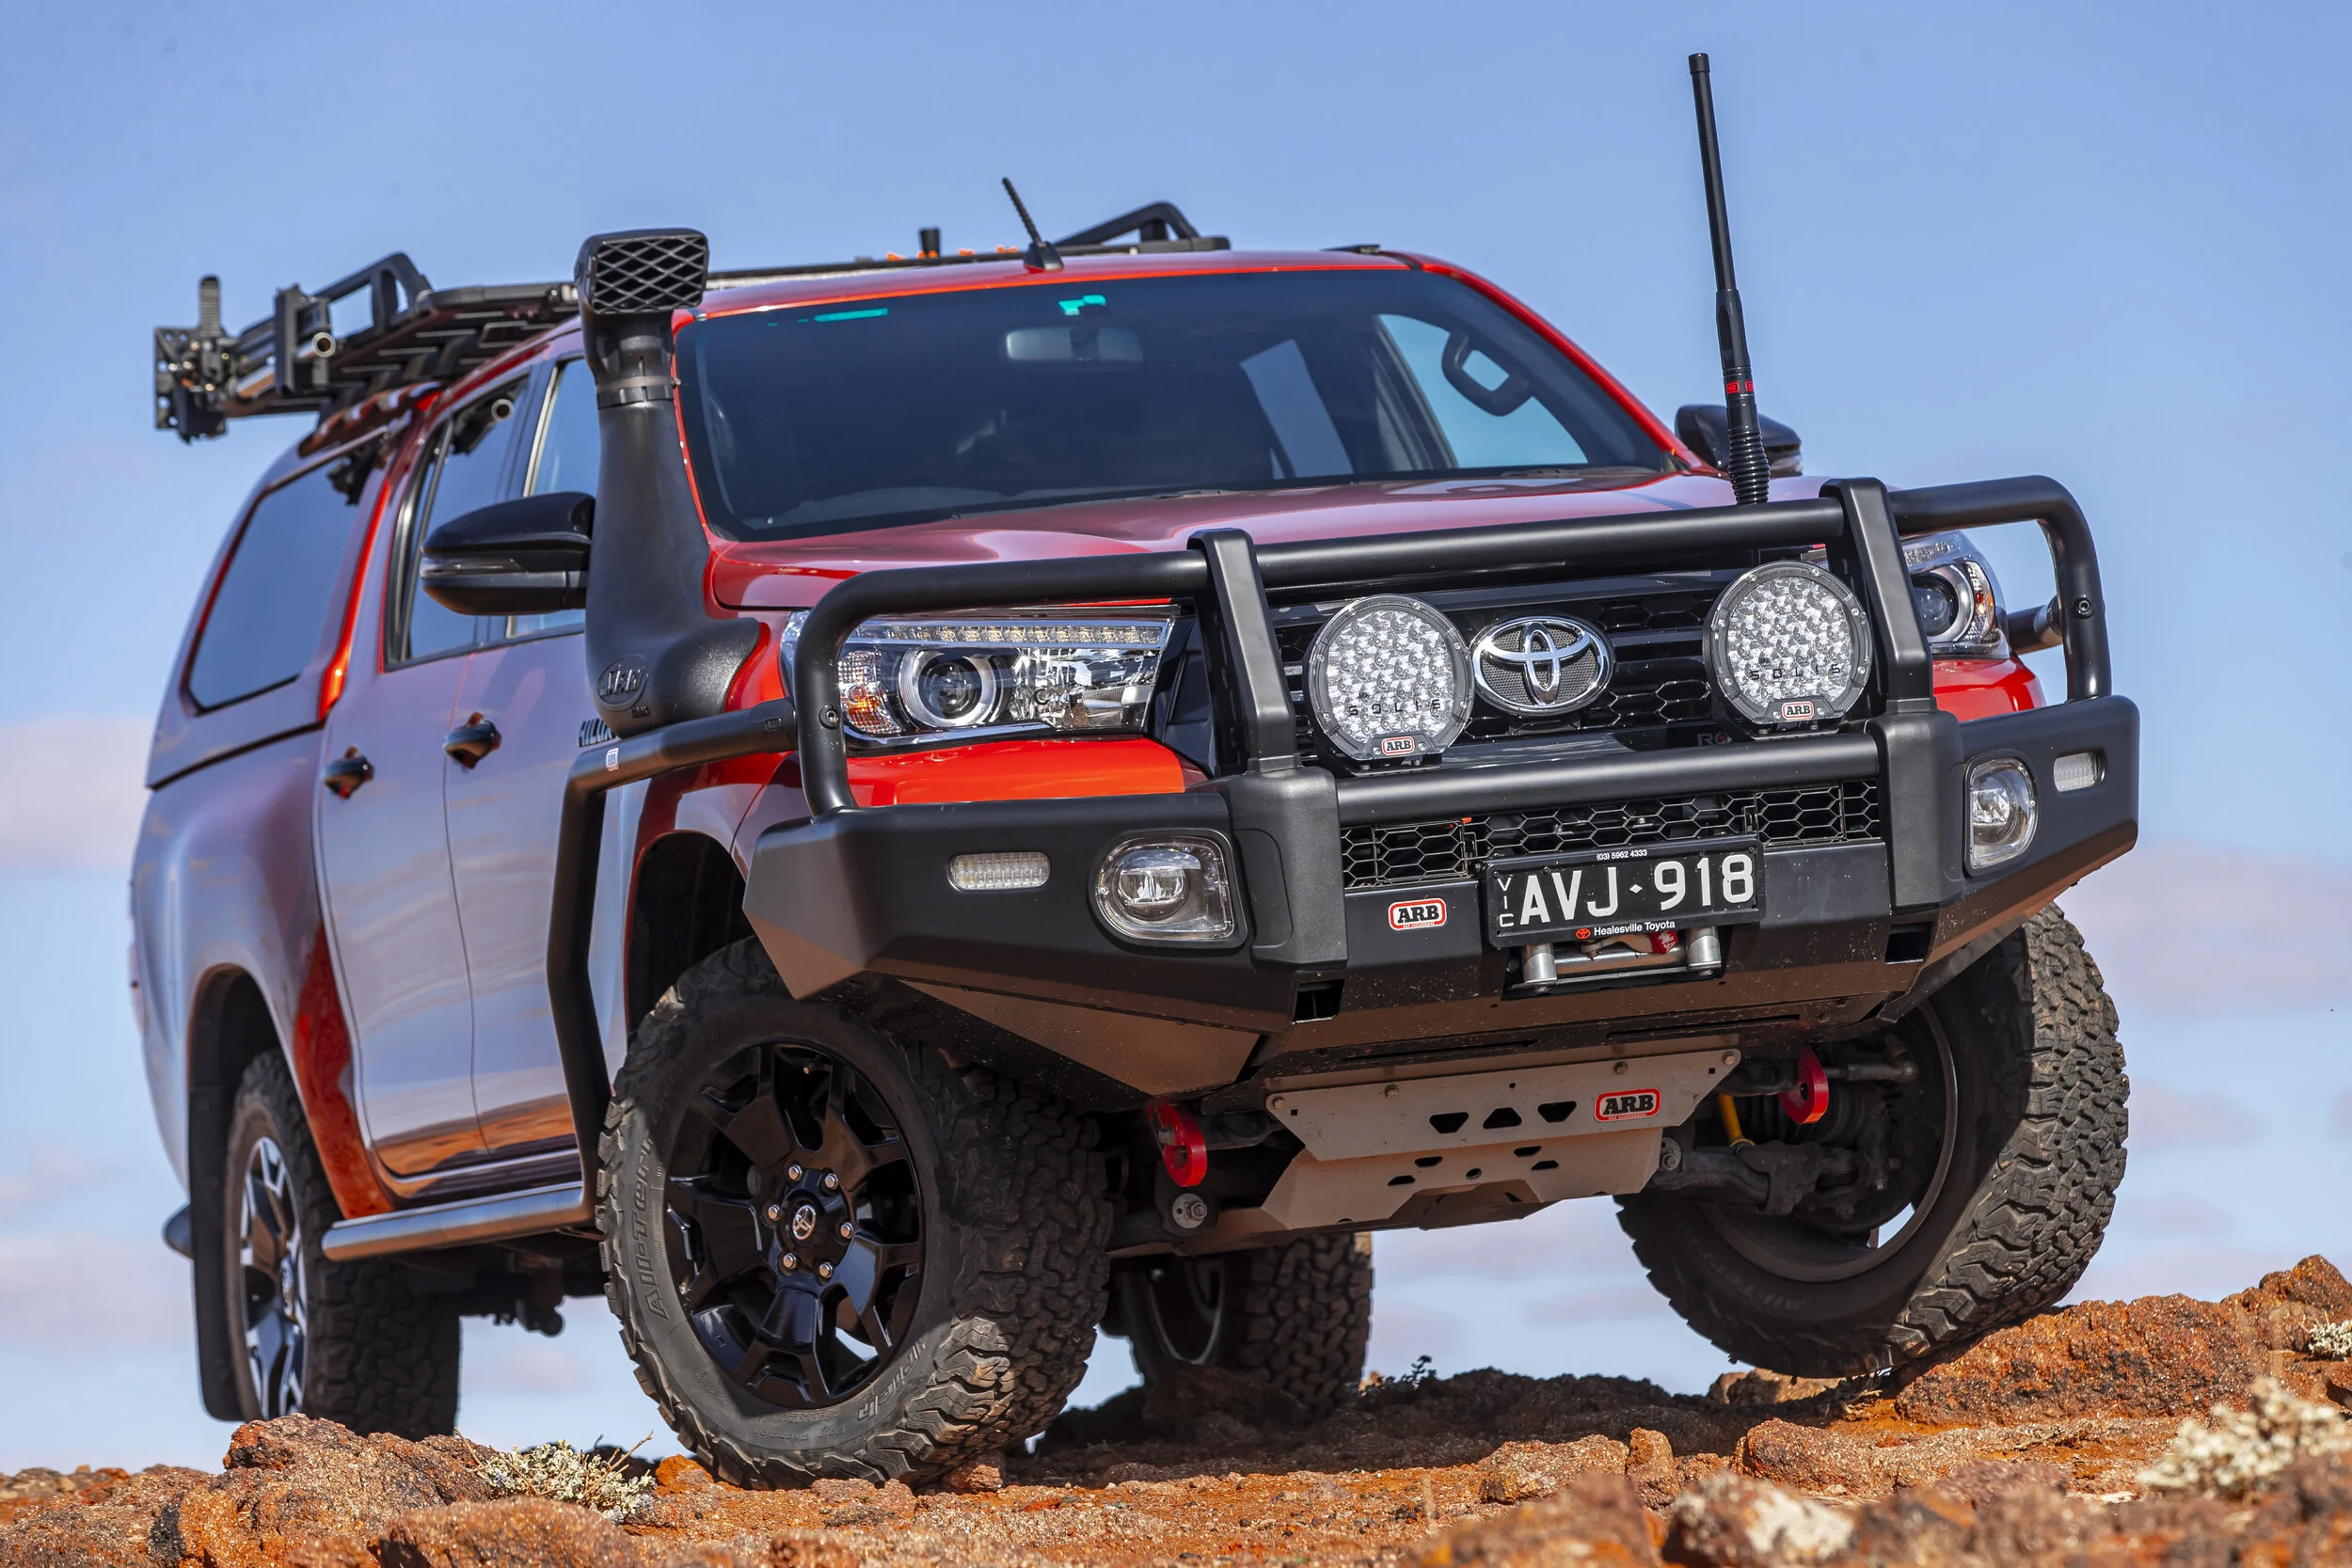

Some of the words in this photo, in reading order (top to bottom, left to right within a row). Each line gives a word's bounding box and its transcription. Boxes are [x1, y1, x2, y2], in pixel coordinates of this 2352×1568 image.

[1750, 663, 1841, 681] SOLIS
[1786, 705, 1811, 716] ARB
[1386, 739, 1412, 752] ARB
[1597, 852, 1610, 861] (03)
[1611, 850, 1629, 860] 5962
[1629, 848, 1647, 857] 4333
[1497, 877, 1516, 927] VIC
[1397, 904, 1440, 924] ARB
[1594, 923, 1643, 936] Healesville
[1644, 920, 1676, 932] Toyota
[1602, 1094, 1654, 1116] ARB
